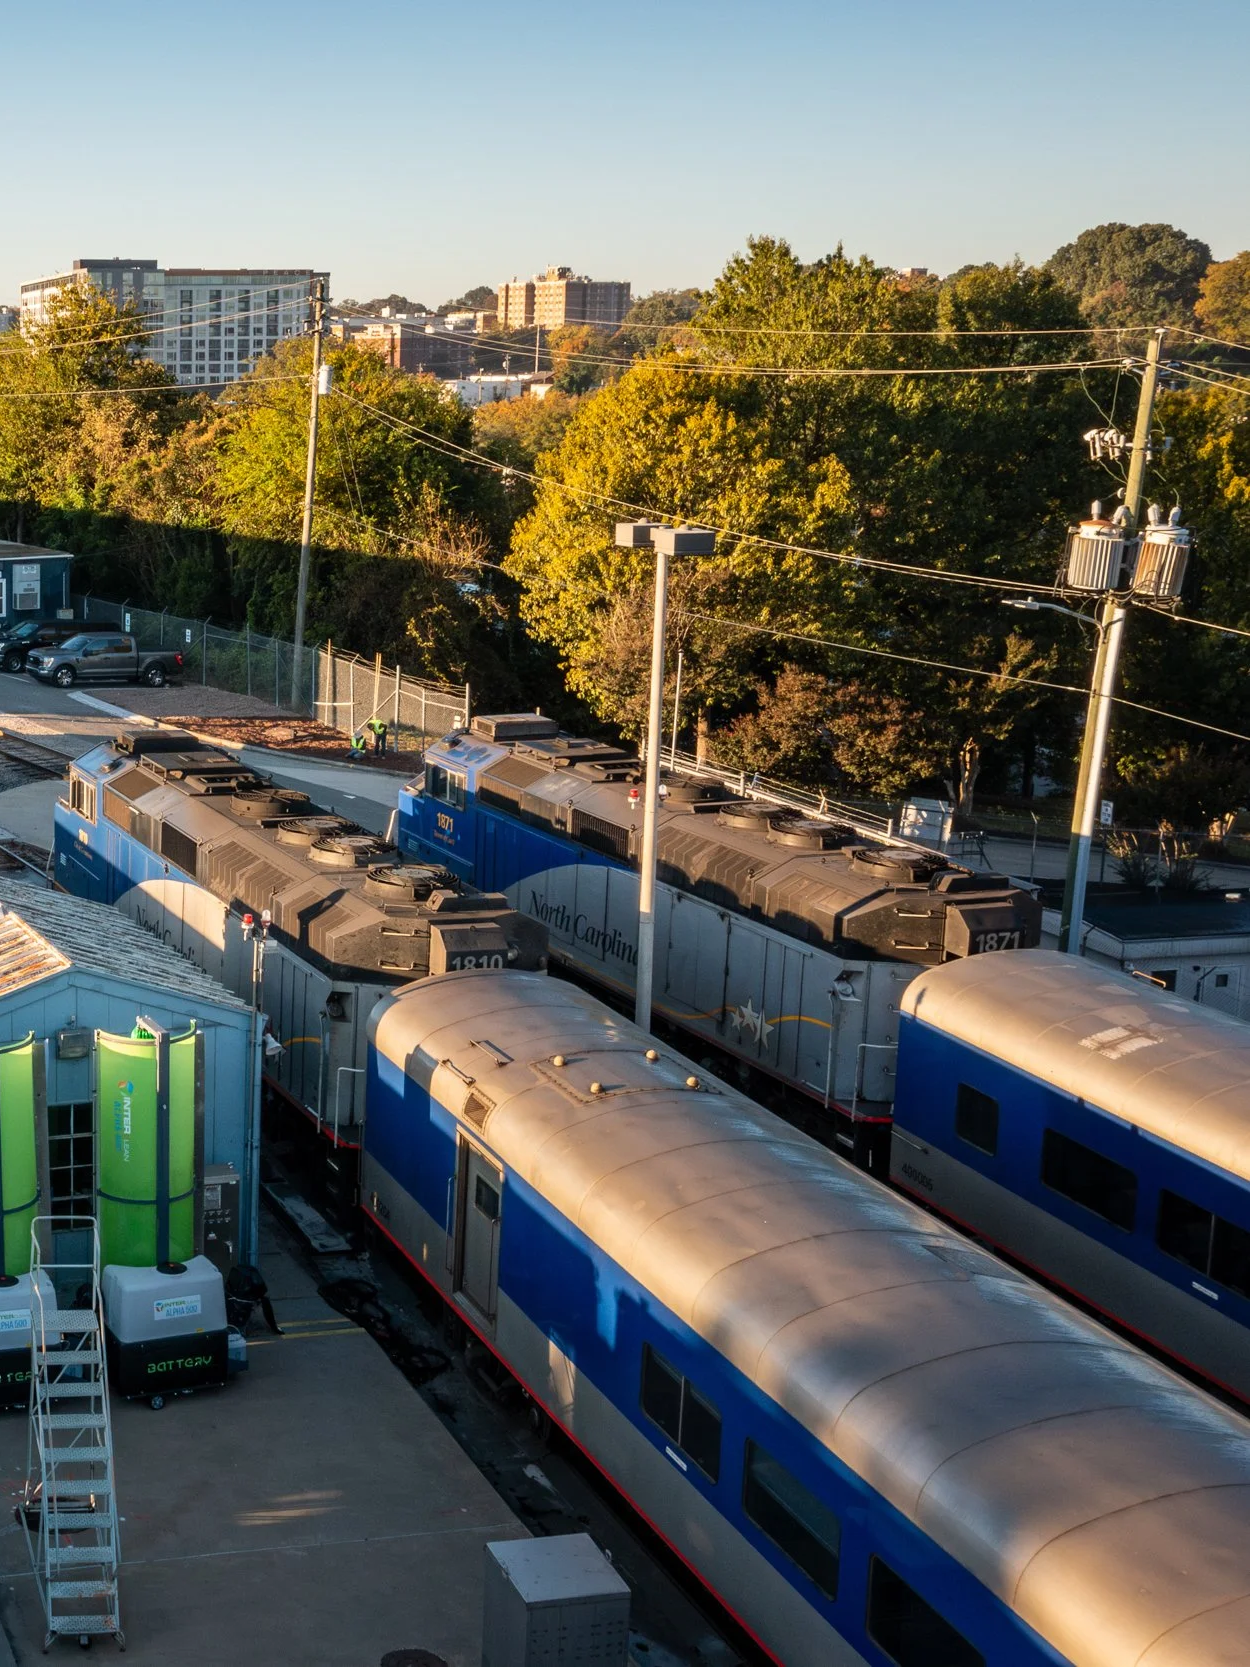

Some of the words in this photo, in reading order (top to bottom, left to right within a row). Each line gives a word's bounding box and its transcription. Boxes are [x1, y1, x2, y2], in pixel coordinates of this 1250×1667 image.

[437, 812, 453, 833] 1871
[529, 889, 570, 933] North
[975, 931, 1020, 953] 1871
[452, 954, 503, 970] 1810
[147, 1355, 212, 1374] BATTERY
